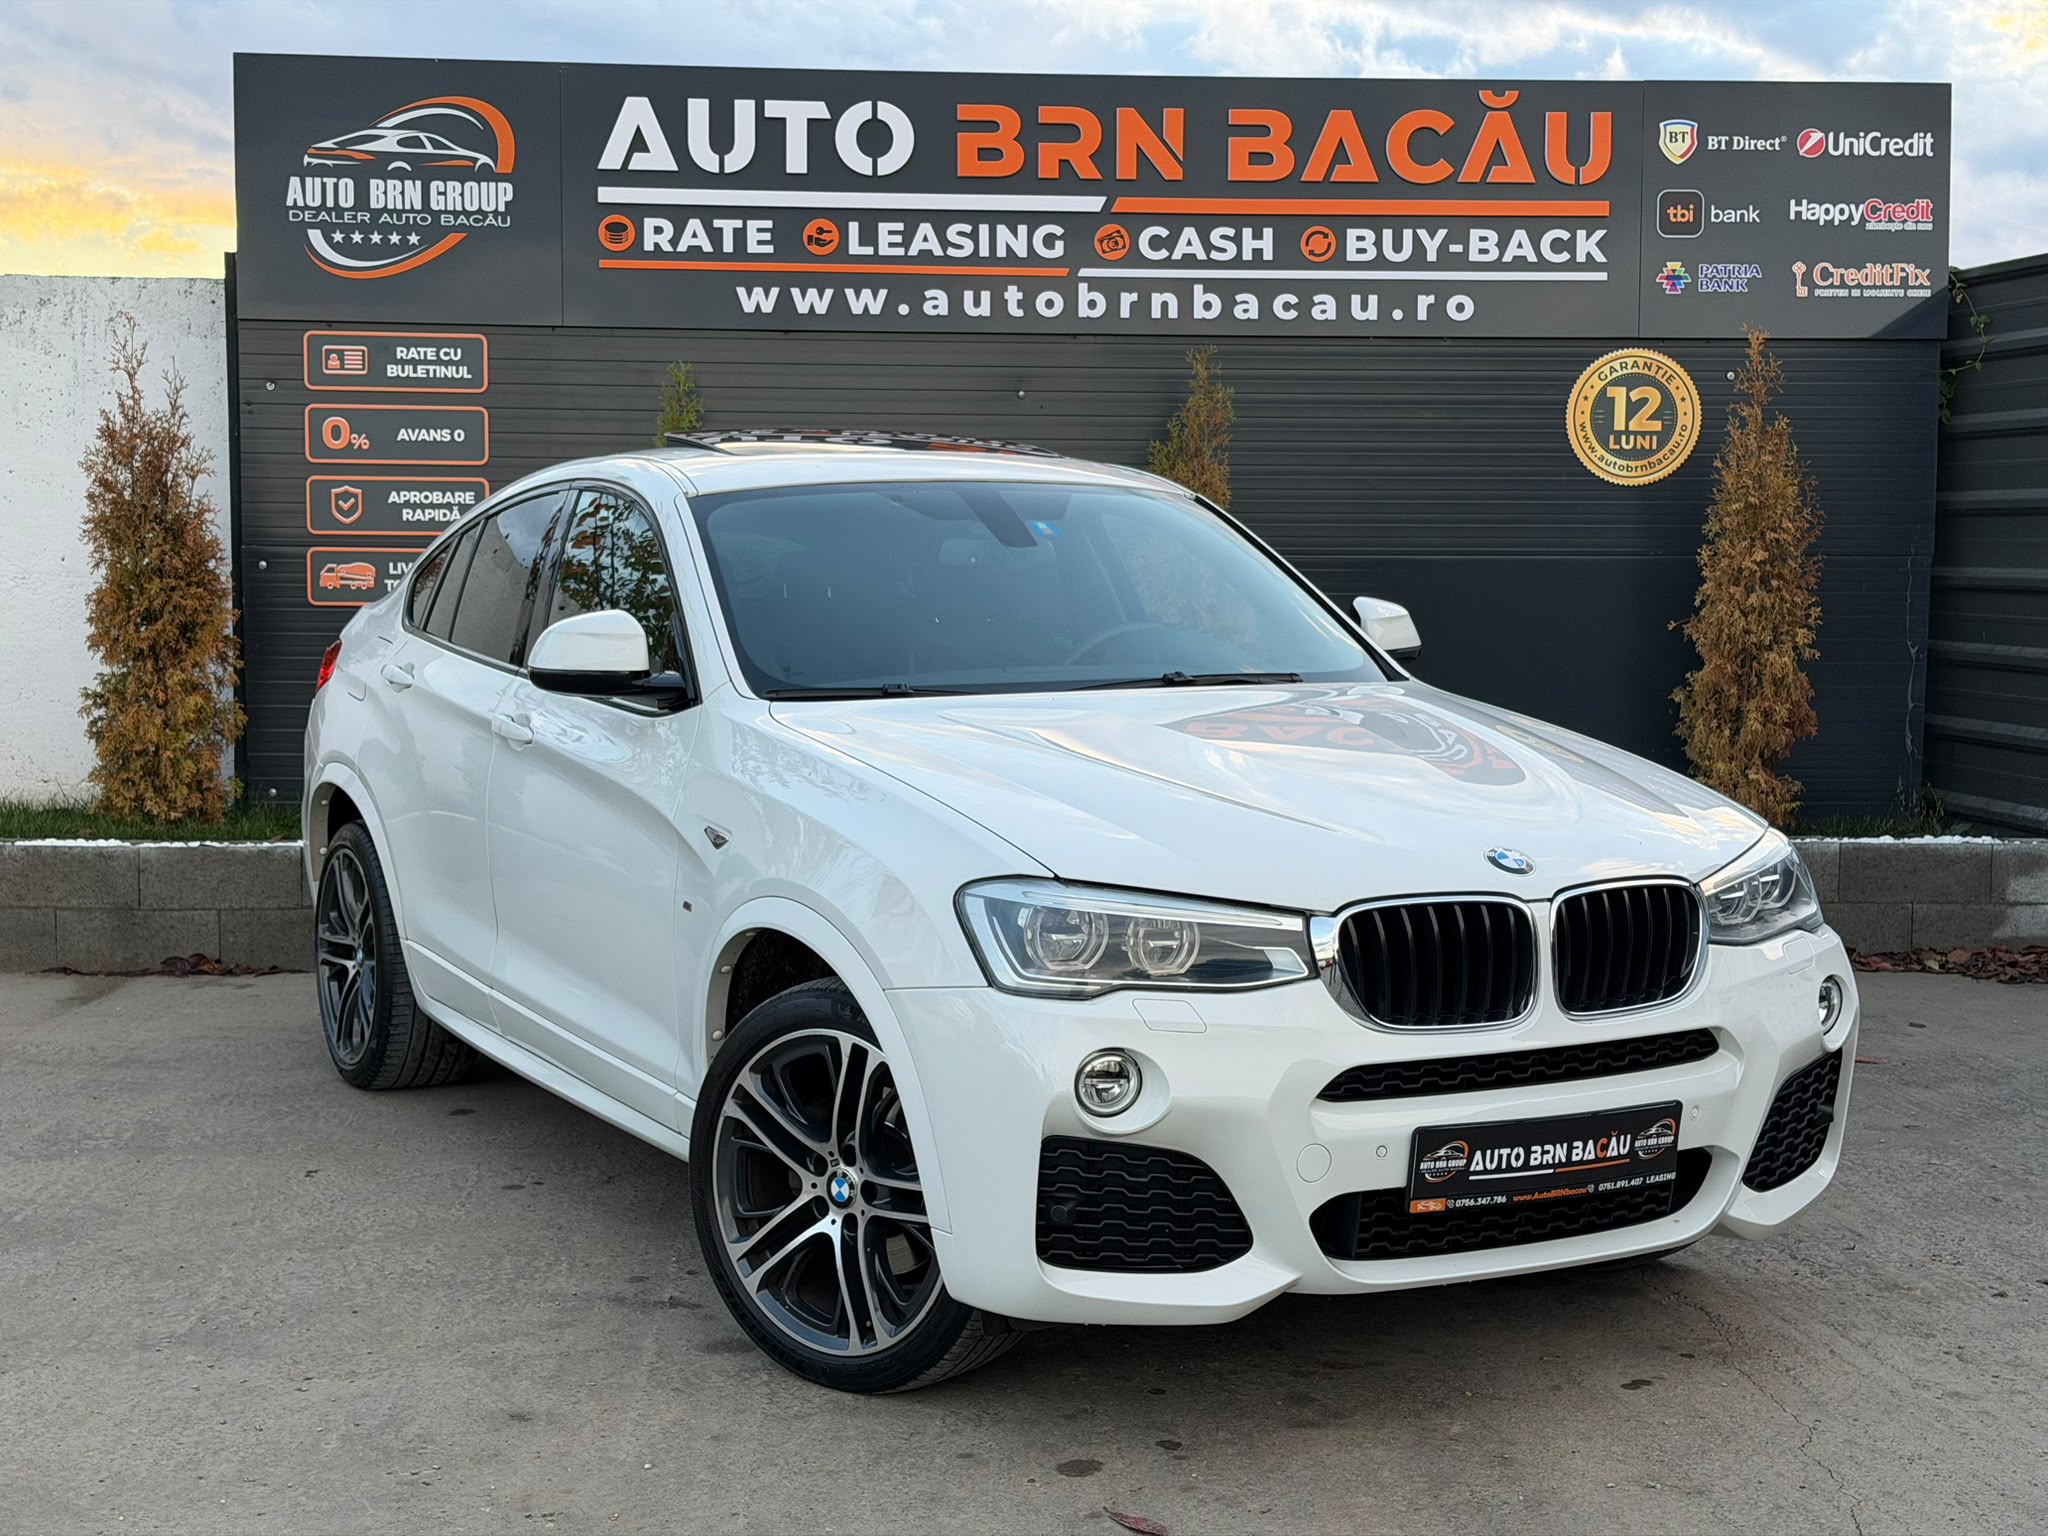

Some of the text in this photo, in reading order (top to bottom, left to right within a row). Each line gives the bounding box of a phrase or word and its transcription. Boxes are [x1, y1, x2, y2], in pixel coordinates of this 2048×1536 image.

[597, 89, 1613, 185] AUTO BRN BACĂU
[1669, 131, 1689, 144] BT
[1707, 136, 1729, 150] BT
[1828, 131, 1934, 157] UniCredit
[285, 176, 514, 212] AUTO BRN GROUP
[289, 210, 511, 228] DEALER AUTO BACĂU
[1667, 204, 1760, 223] tbi bank
[1789, 198, 1933, 226] HappyCredit
[642, 217, 1609, 263] RATE LEASING CASH BUY-BACK
[1698, 263, 1762, 278] PATRIA
[1813, 262, 1931, 286] CreditFix
[1698, 279, 1748, 292] BANK
[735, 283, 1475, 322] www.autobrnbacau.ro
[396, 347, 462, 361] RATE CU
[386, 364, 472, 379] BULETINUL
[1597, 360, 1677, 387] GARANTIE
[1606, 386, 1662, 432] 12
[397, 428, 465, 442] AVANS 0
[1609, 434, 1657, 450] LUNI
[1578, 421, 1688, 473] www.autobrnbacau.ro
[387, 491, 475, 505] APROBARE
[402, 506, 461, 521] RAPIDĂ
[1470, 1130, 1631, 1171] AUTO BRN BACĂU
[1646, 1172, 1676, 1185] LEASING
